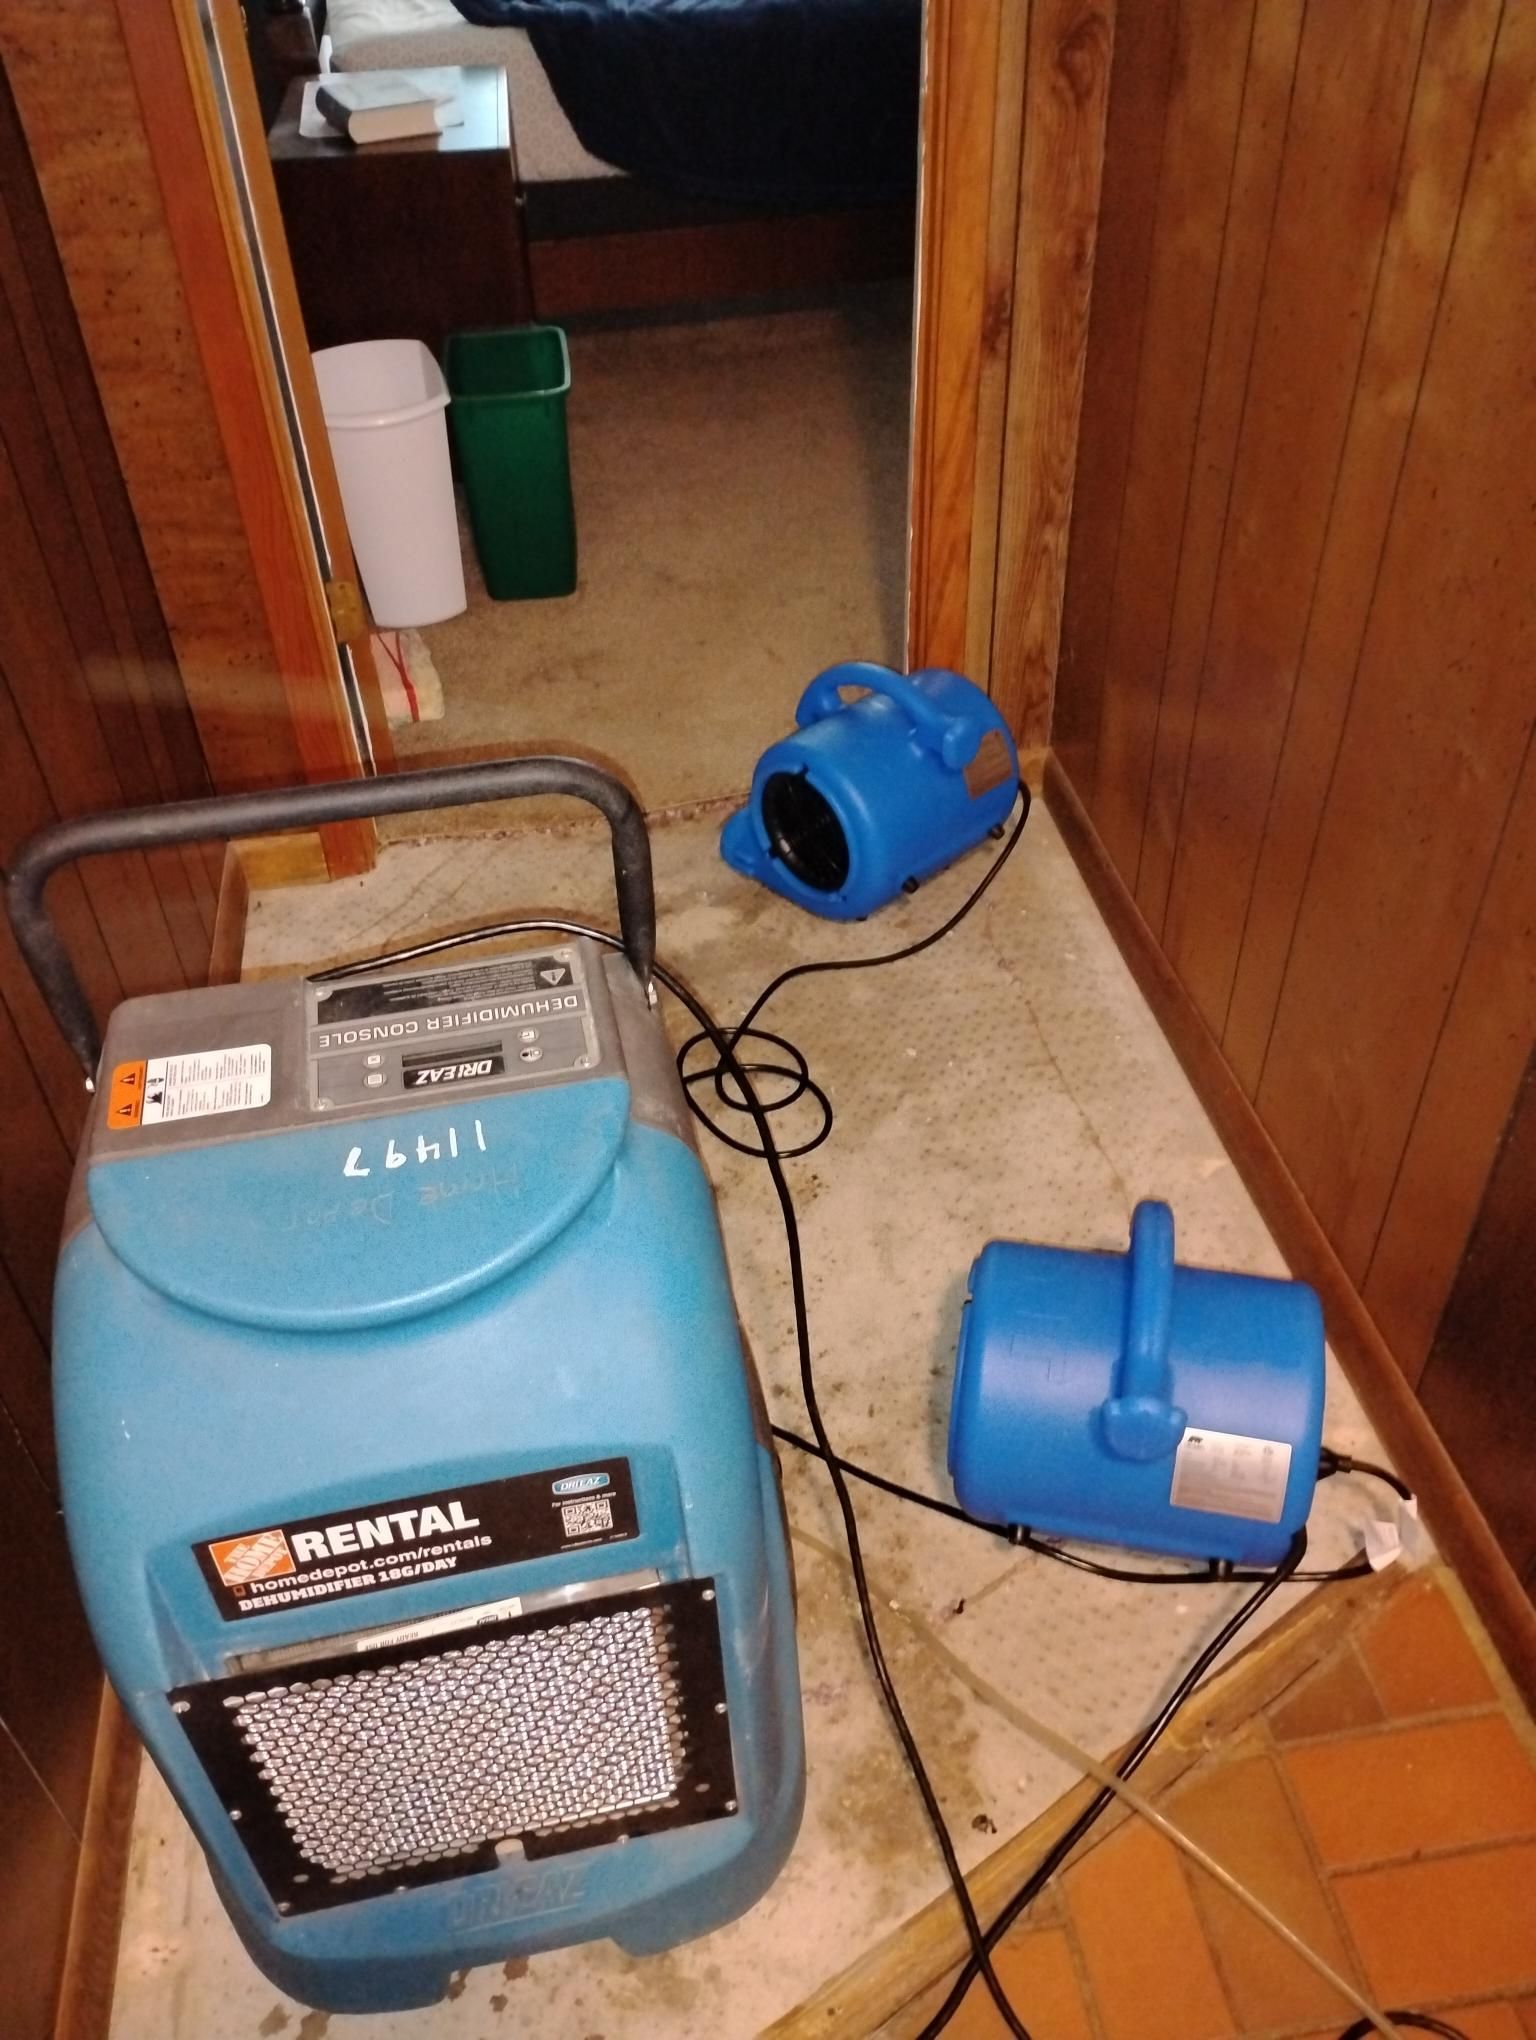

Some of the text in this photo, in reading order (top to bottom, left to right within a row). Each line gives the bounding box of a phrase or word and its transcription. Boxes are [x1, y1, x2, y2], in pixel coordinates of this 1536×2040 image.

[319, 995, 578, 1048] DEHUMIDIFIER CONSOLE
[343, 1119, 487, 1178] 11497
[291, 1501, 480, 1562] RENTAL
[238, 1556, 457, 1611] DEHUMIDIFIER 18G/DAY
[251, 1535, 492, 1594] homedepot.com/rentals
